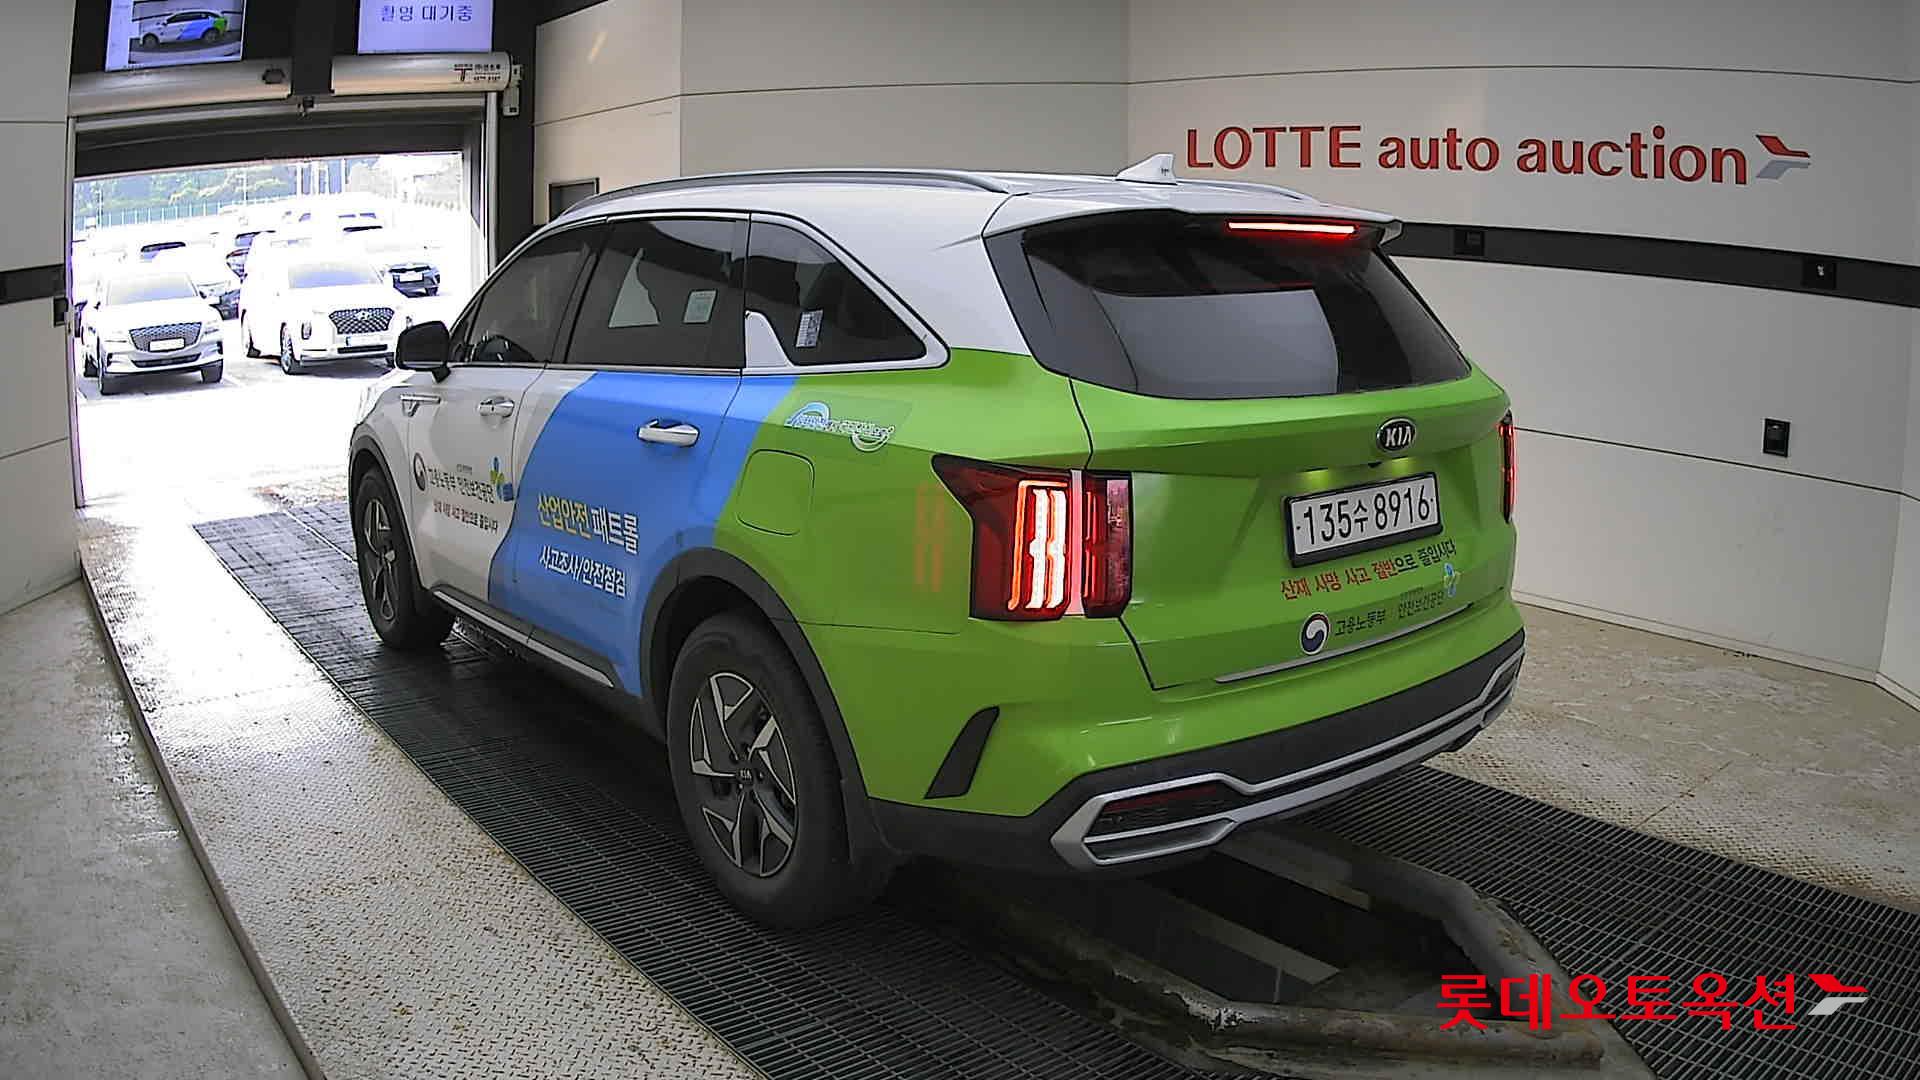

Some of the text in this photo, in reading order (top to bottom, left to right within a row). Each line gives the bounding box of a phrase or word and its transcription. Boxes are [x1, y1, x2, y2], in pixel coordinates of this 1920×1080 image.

[422, 5, 472, 21] 대기중
[1186, 125, 1748, 186] LOTTE auto auction
[1384, 426, 1412, 446] KIA
[538, 494, 639, 555] 산업안전 패트롤
[539, 546, 626, 598] 사고조사/안전점검
[1281, 538, 1457, 600] 산재 사망 사고 절반으로 줄입시다
[1335, 609, 1386, 636] 고용노동부
